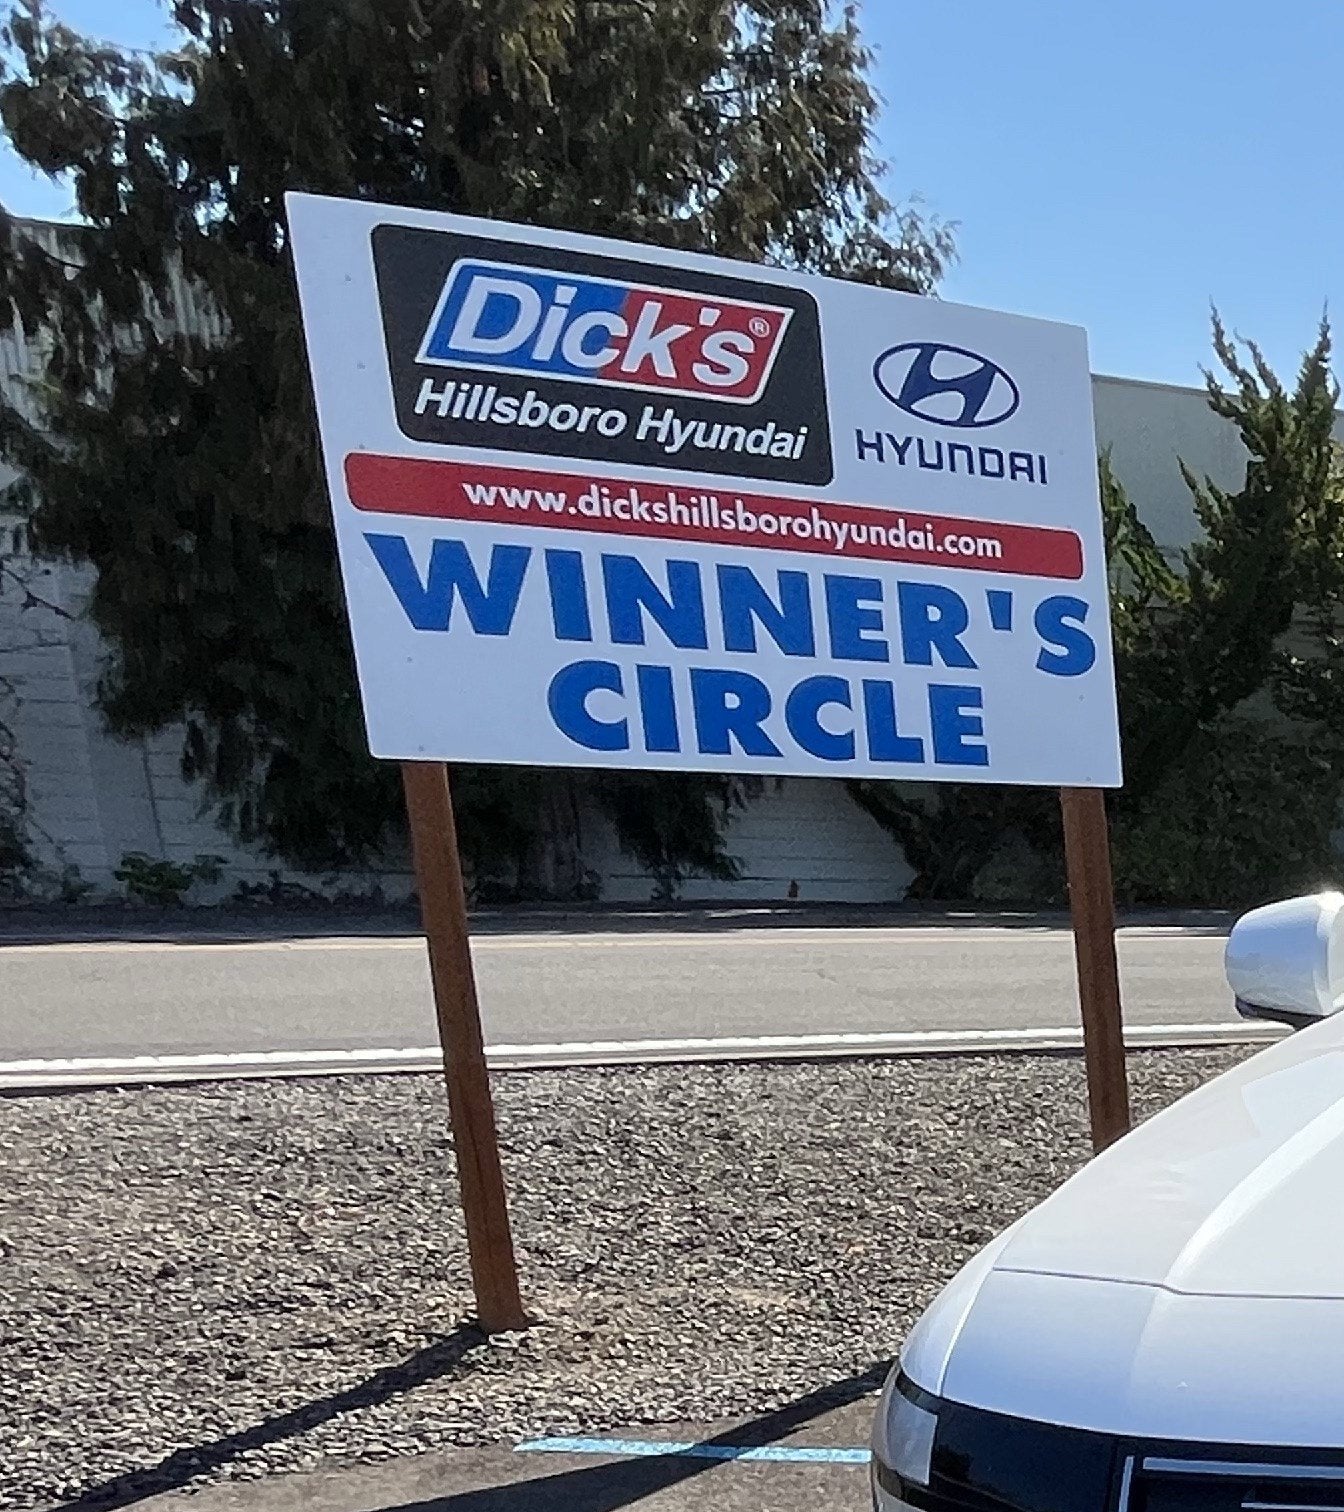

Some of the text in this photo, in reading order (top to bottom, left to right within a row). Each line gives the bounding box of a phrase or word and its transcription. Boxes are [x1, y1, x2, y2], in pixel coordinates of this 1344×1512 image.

[448, 277, 757, 387] Dick's
[413, 377, 808, 460] Hillsboro Hyundai
[856, 429, 1048, 484] HYUNDAI
[462, 481, 1003, 560] www.dickshillsborohyundai.com
[363, 532, 1096, 677] WINNER'S
[548, 660, 989, 766] CIRCLE
